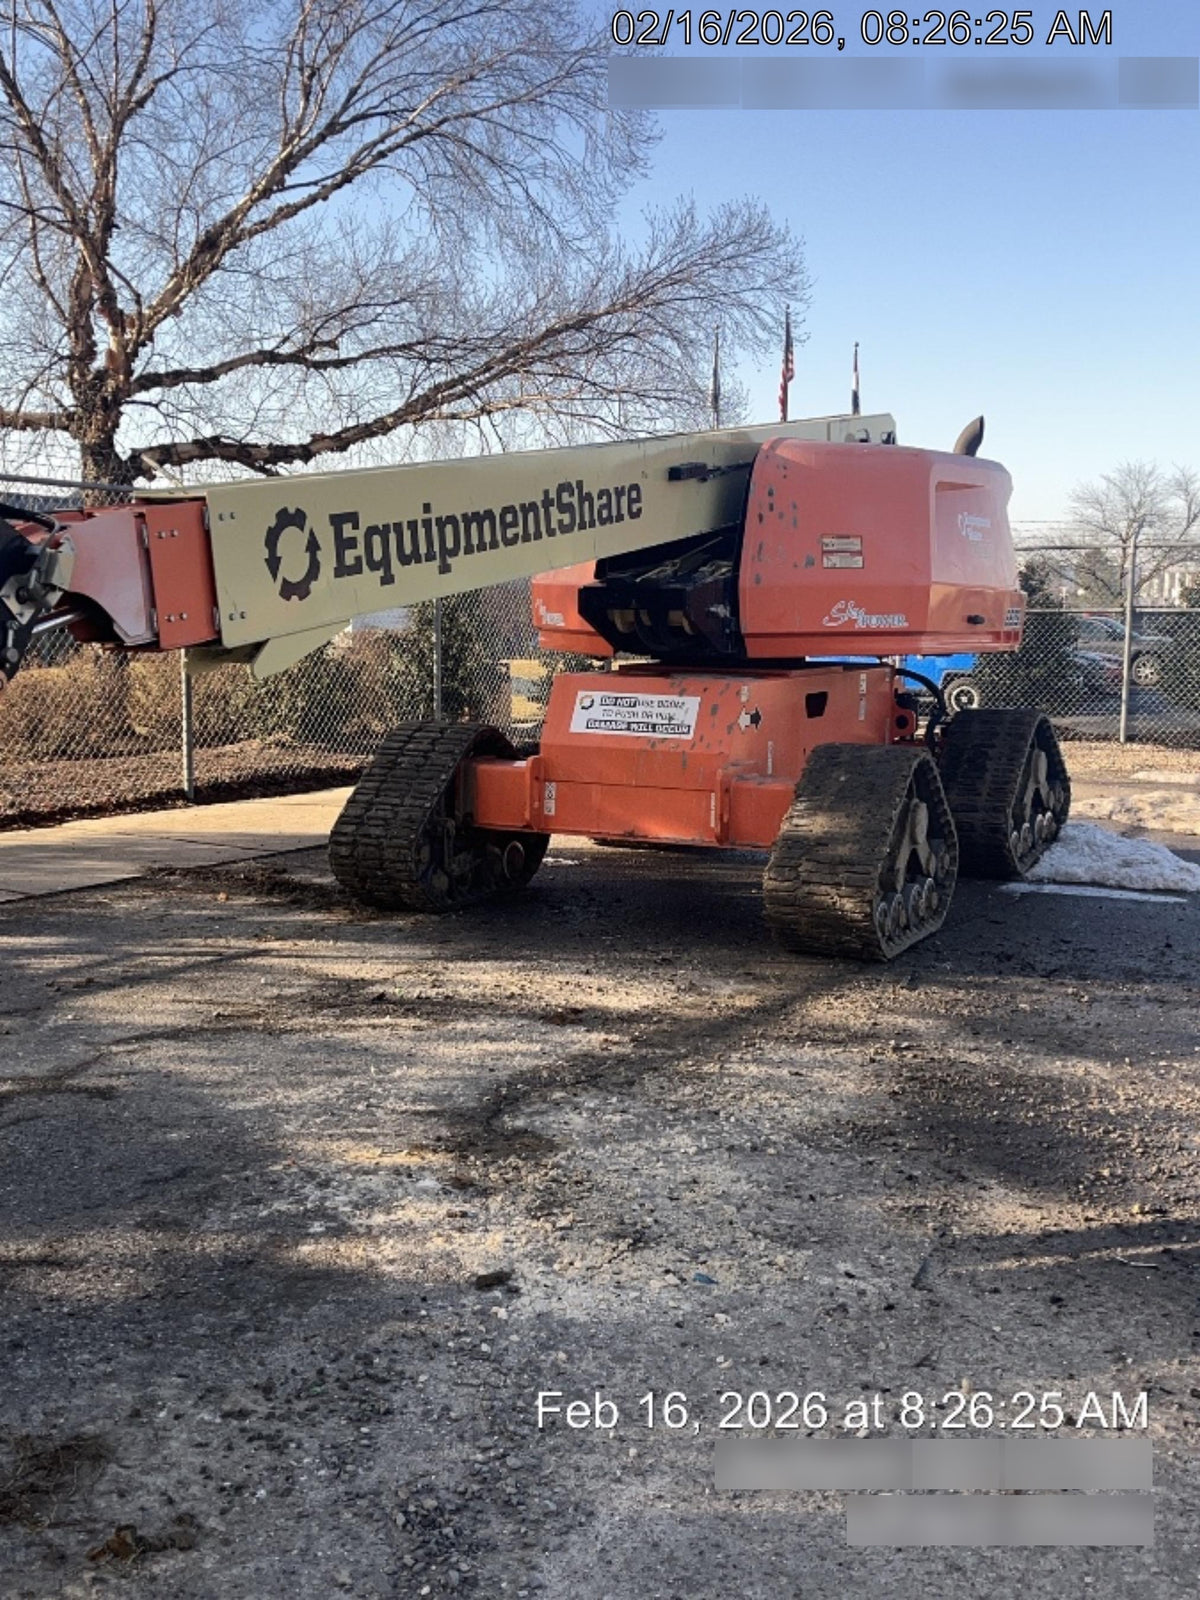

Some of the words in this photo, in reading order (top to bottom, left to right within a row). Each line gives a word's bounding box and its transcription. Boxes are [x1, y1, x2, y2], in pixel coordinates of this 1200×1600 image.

[329, 479, 643, 587] EquipmentShare
[617, 698, 636, 707] NOT
[630, 722, 654, 732] WILL
